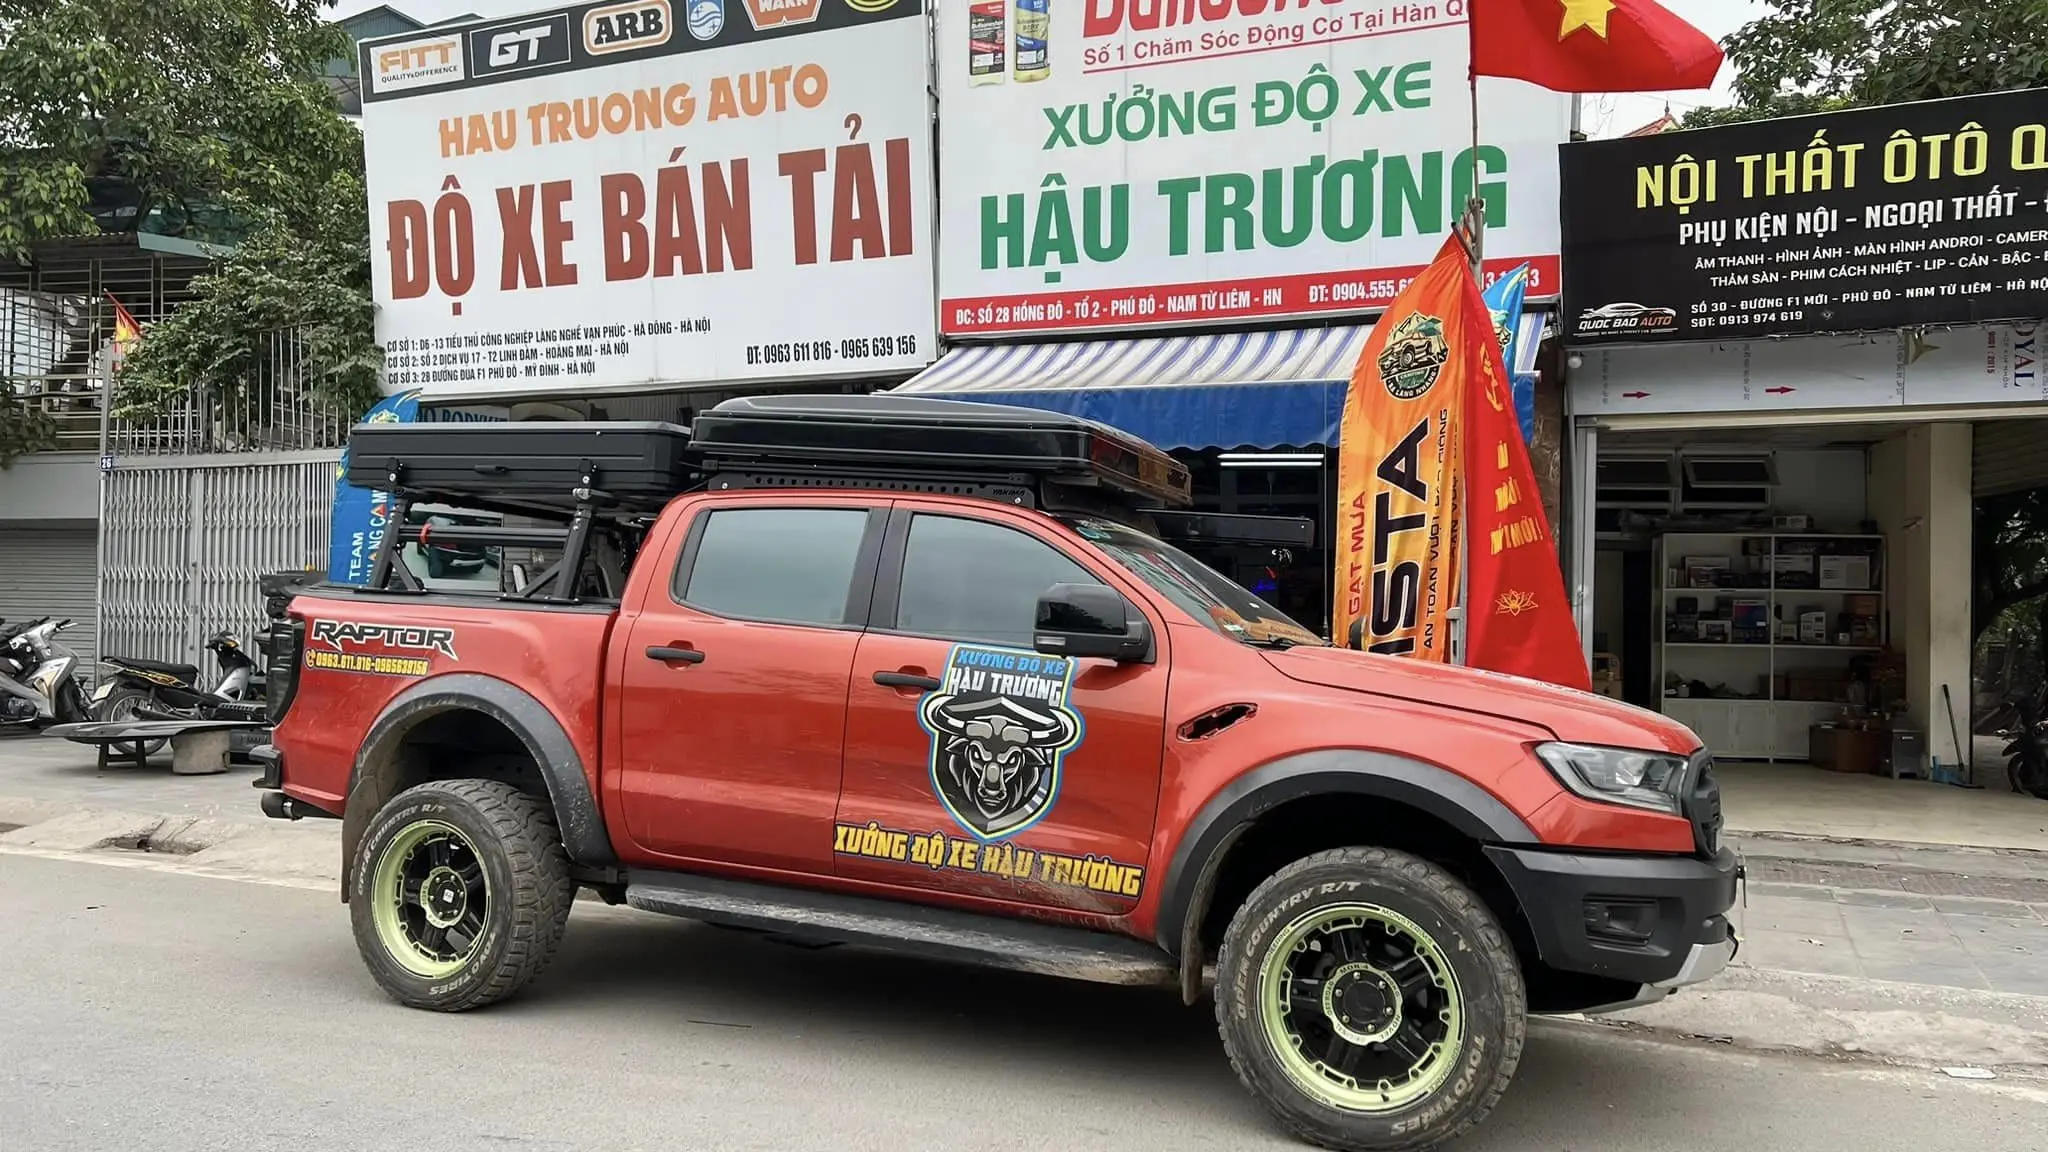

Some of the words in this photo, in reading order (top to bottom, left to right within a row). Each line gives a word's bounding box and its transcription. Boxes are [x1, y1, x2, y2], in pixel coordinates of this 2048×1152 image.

[488, 25, 552, 68] GT
[594, 8, 664, 45] ARB
[1084, 43, 1112, 66] Số
[1116, 45, 1125, 61] 1
[1134, 38, 1193, 60] Chăm
[1200, 30, 1241, 50] Sóc
[1247, 24, 1304, 46] Động
[1312, 16, 1344, 36] Cơ
[1350, 9, 1384, 32] Tại
[1392, 2, 1437, 25] Hàn
[379, 42, 457, 73] FITT
[439, 114, 517, 158] HAU
[527, 81, 697, 146] TRUONG
[708, 63, 828, 121] AUTO
[1043, 81, 1238, 151] XƯỞNG
[1251, 63, 1341, 133] ĐỘ
[1353, 61, 1432, 116] XE
[1636, 153, 1716, 215] NỘI
[1735, 128, 1864, 198] THẤT
[1882, 121, 1988, 184] ÔTÔ
[387, 174, 476, 316] ĐỘ
[496, 179, 579, 291] XE
[601, 146, 753, 282] BÁN
[778, 112, 914, 266] TẢI
[980, 171, 1129, 283] HẬU
[1158, 144, 1508, 256] TRƯƠNG
[1679, 219, 1727, 247] PHỤ
[1735, 211, 1788, 243] KIỆN
[1796, 206, 1838, 238] NỘI
[1865, 199, 1944, 229] NGOẠI
[1951, 184, 2019, 221] THẤT
[1710, 272, 1749, 288] THẢM
[1751, 270, 1779, 284] SÀN
[1790, 268, 1826, 281] PHIM
[1829, 262, 1867, 278] CÁCH
[1870, 260, 1913, 276] NHIỆT
[1924, 258, 1947, 271] LIP
[1958, 253, 1989, 268] CẢN
[2001, 250, 2032, 266] BẬC
[1718, 253, 1765, 269] THANH
[1775, 249, 1809, 264] HÌNH
[1812, 246, 1842, 260] ẢNH
[1854, 242, 1887, 257] MÀN
[1890, 239, 1926, 254] HÌNH
[1929, 235, 1984, 250] ANDROI
[977, 301, 993, 324] SỐ
[995, 307, 1010, 323] 28
[1073, 295, 1089, 318] TỔ
[1091, 301, 1100, 318] 2
[1110, 295, 1136, 317] PHÚ
[1167, 294, 1197, 313] NAM
[1200, 289, 1218, 311] TỪ
[1219, 287, 1251, 310] LIÊM
[1263, 287, 1282, 307] HN
[1309, 284, 1329, 303] ĐT:
[1711, 302, 1727, 312] 30
[1787, 296, 1800, 307] F1
[1804, 293, 1828, 305] MỚI
[1906, 286, 1935, 299] NAM
[1961, 281, 1992, 294] LIÊM
[2006, 278, 2026, 291] HÀ
[603, 323, 626, 339] PHÚC
[634, 321, 646, 336] HÀ
[680, 318, 693, 333] HÀ
[695, 316, 711, 334] NỘI
[1719, 314, 1749, 325] 0913
[1753, 312, 1776, 323] 974
[1781, 310, 1803, 321] 619
[499, 349, 517, 362] LINH
[576, 345, 592, 358] MAI
[600, 341, 612, 356] HÀ
[614, 340, 629, 357] NỘI
[567, 360, 579, 375] HÀ
[581, 358, 595, 376] NỘI
[764, 343, 790, 364] 0963
[794, 342, 810, 362] 611
[813, 340, 831, 361] 816
[841, 338, 869, 359] 0965
[872, 336, 893, 357] 639
[896, 334, 916, 355] 156
[1350, 491, 1365, 553] MƯA
[1368, 417, 1429, 655] ISTA
[349, 531, 364, 581] TEAM
[1348, 560, 1364, 616] GẠT
[311, 618, 459, 662] RAPTOR
[1424, 623, 1434, 650] AN
[946, 666, 987, 697] HẬU
[991, 671, 1064, 708] TRƯƠNG
[1043, 659, 1066, 676] XE
[421, 803, 447, 813] R/T
[834, 822, 909, 862] XƯỞNG
[911, 831, 946, 870] ĐỘ
[947, 839, 980, 869] XE
[981, 842, 1035, 879] HẬU
[1039, 852, 1143, 897] TRƯƠNG
[1235, 956, 1251, 1020] OPEN
[1246, 887, 1315, 958] COUNTRY
[1320, 881, 1362, 895] R/T
[429, 972, 475, 996] TIRES
[1454, 1035, 1486, 1098] TOYO
